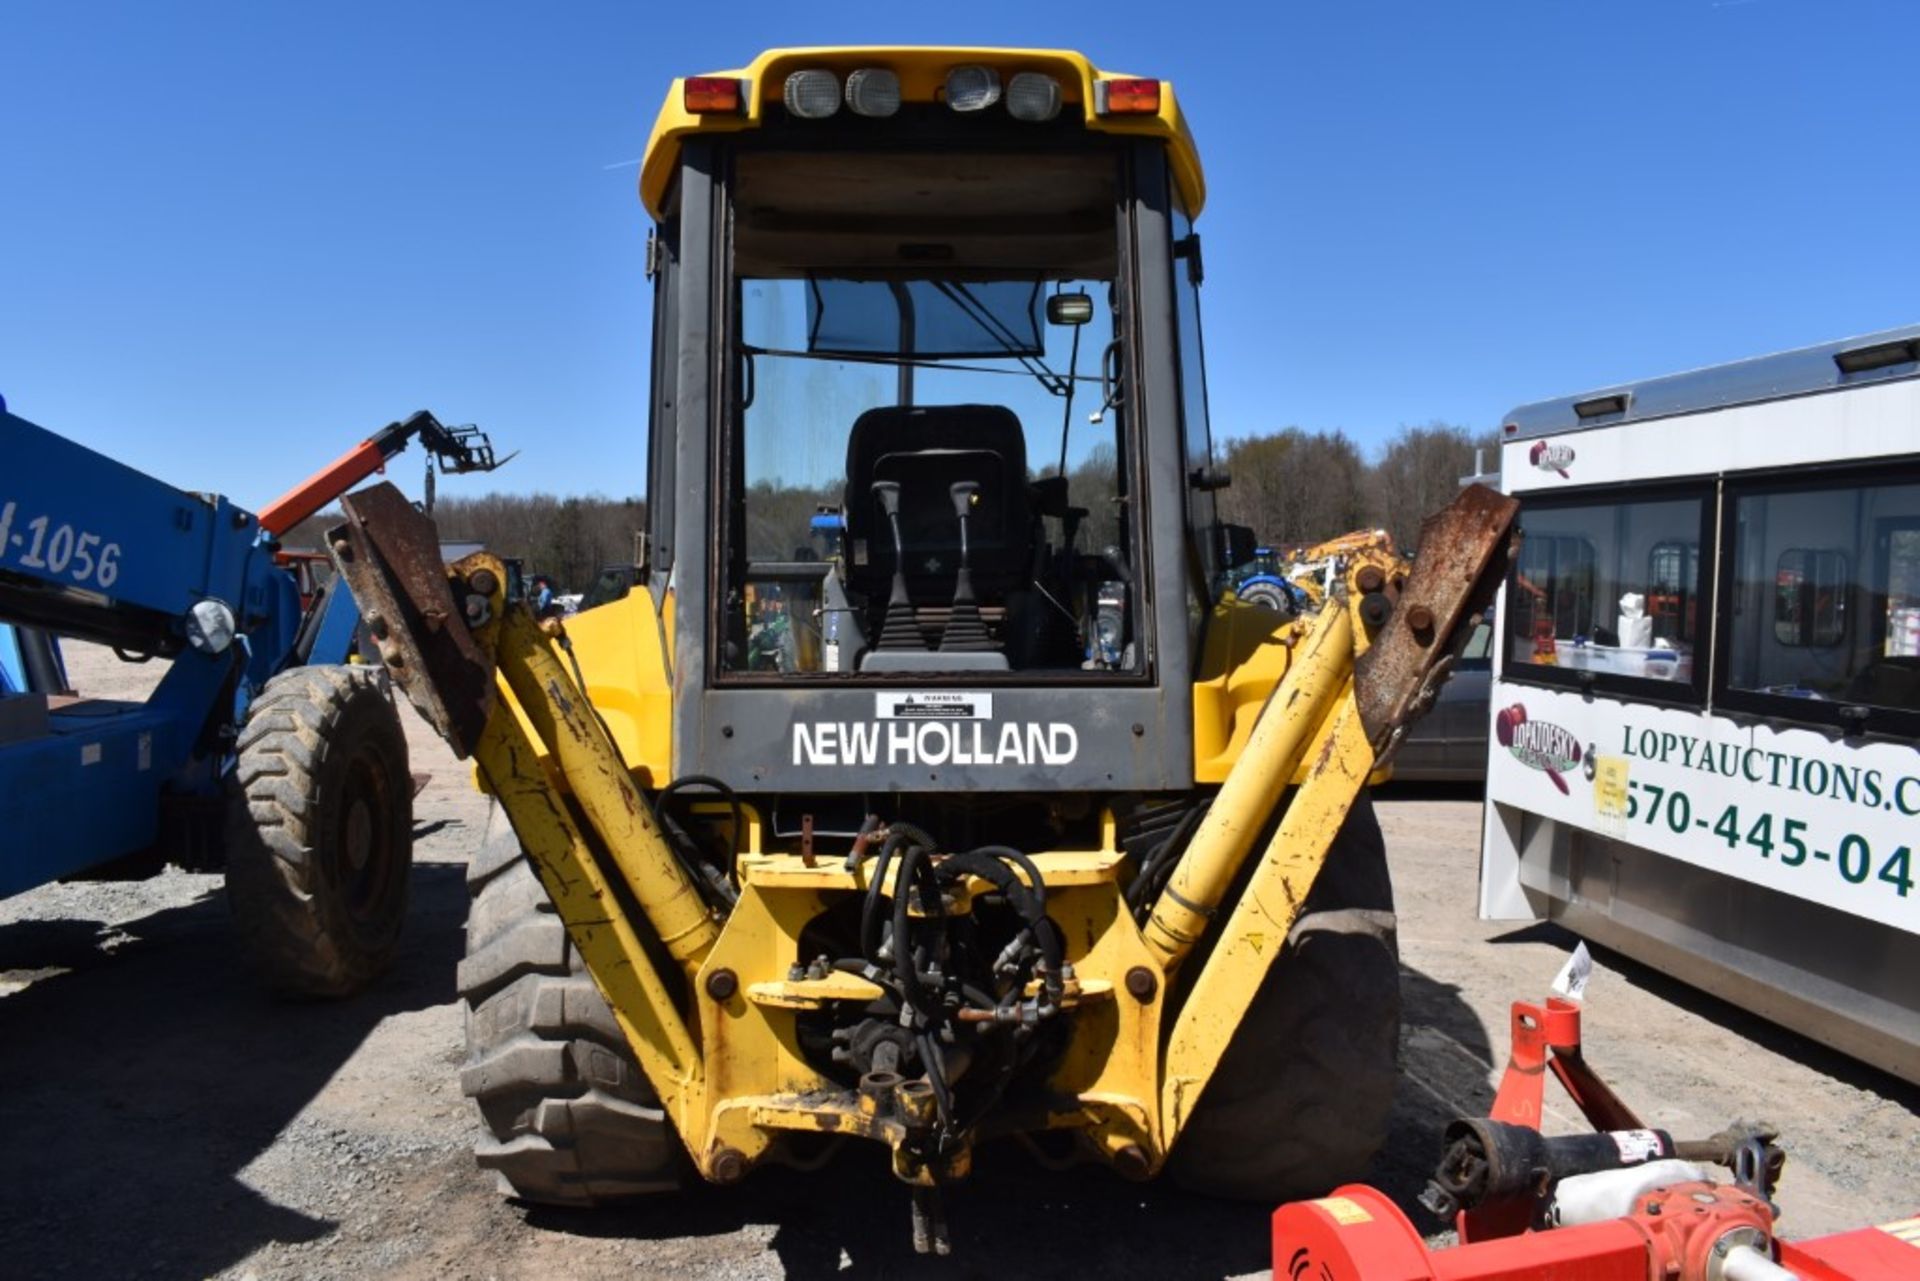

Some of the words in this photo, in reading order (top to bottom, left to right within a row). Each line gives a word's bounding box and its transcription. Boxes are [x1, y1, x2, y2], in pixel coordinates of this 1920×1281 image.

[793, 722, 880, 765] NEW
[888, 721, 1079, 766] HOLLAND
[1626, 780, 1915, 898] 570-445-04
